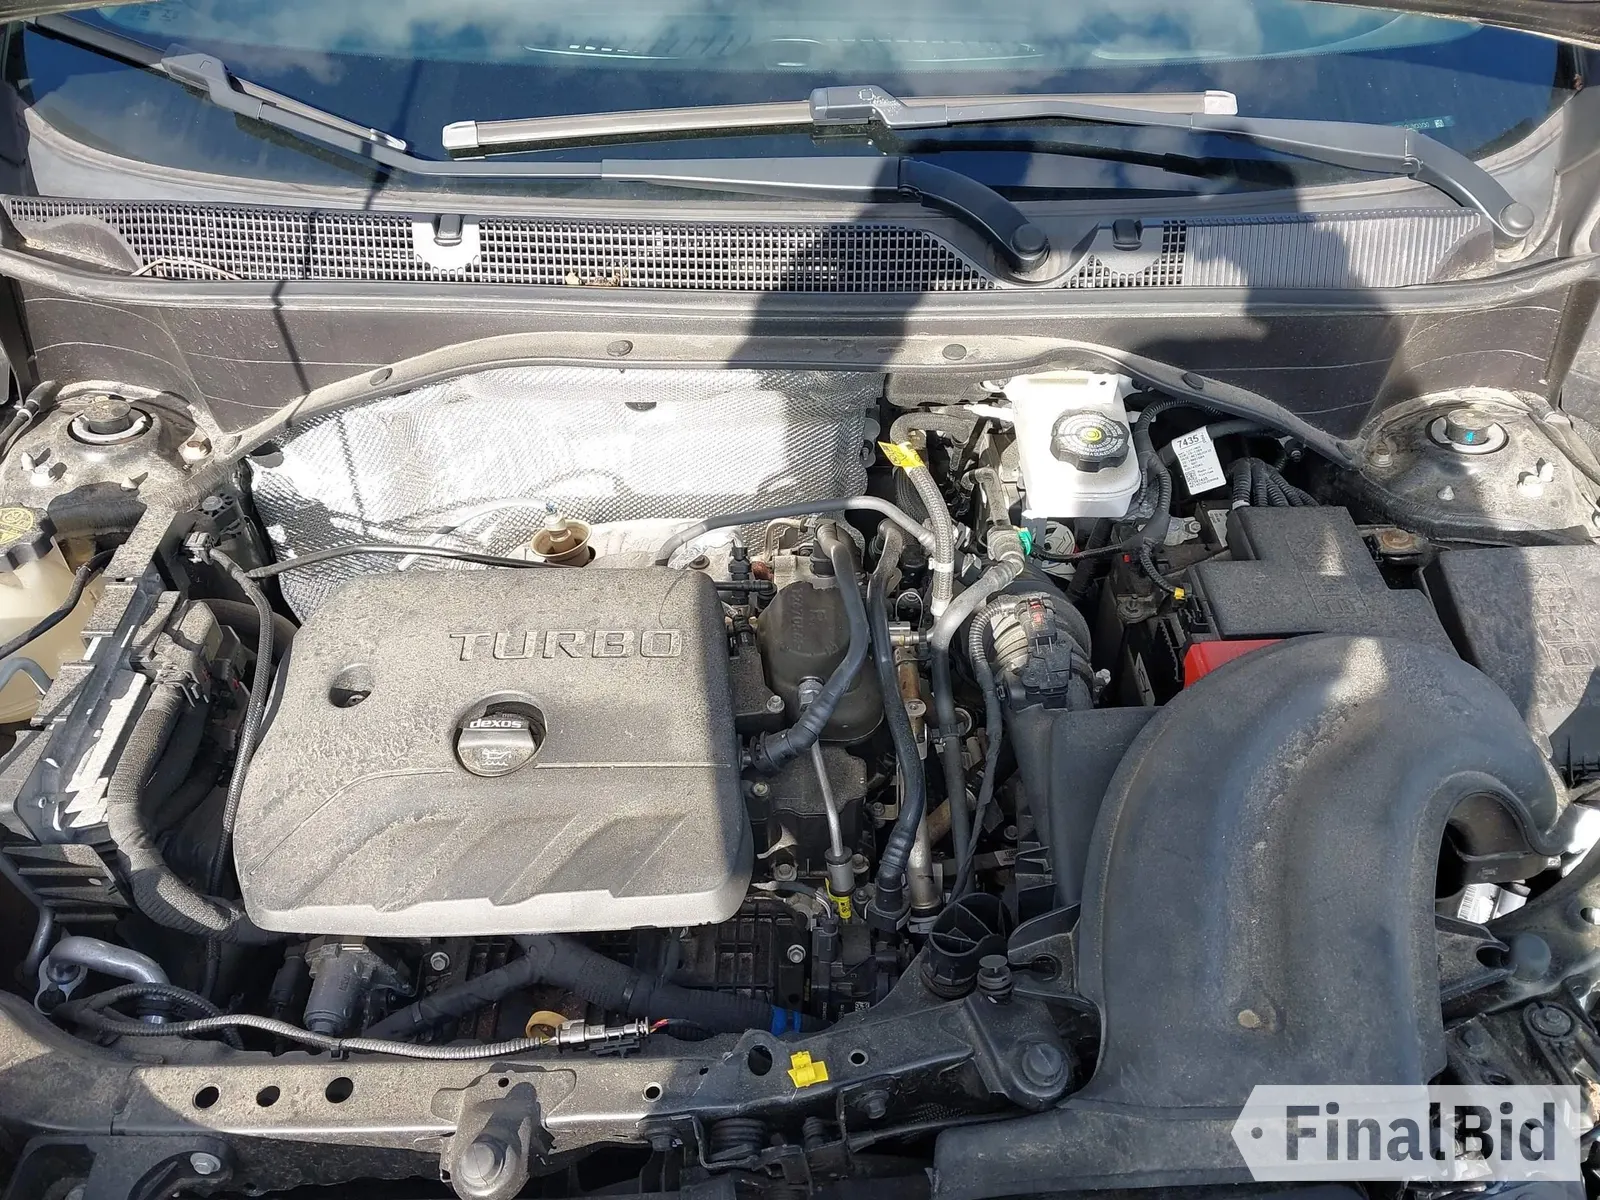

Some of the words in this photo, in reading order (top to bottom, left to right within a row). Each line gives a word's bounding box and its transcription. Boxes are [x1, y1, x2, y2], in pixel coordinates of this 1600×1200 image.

[1177, 434, 1200, 449] 7435
[449, 629, 682, 661] TURBO
[469, 718, 522, 729] dexos
